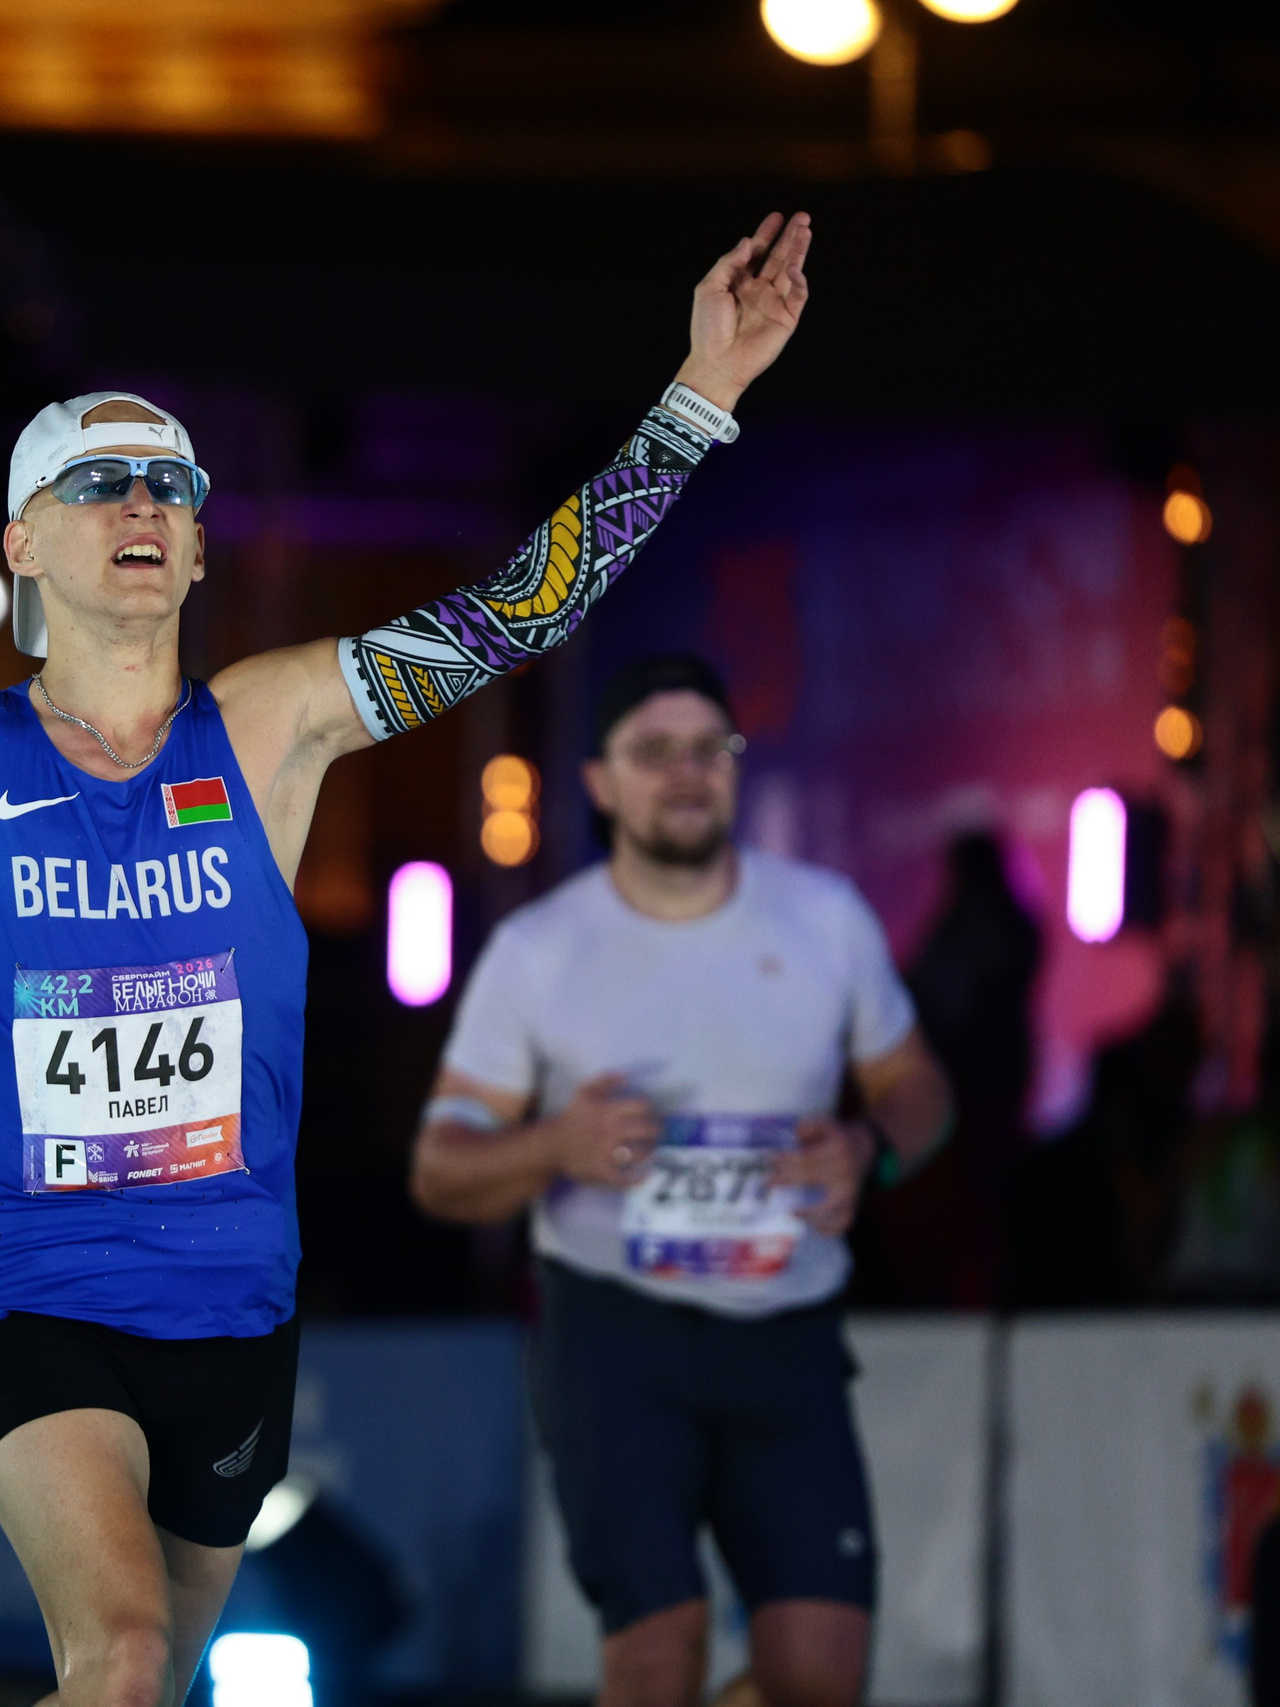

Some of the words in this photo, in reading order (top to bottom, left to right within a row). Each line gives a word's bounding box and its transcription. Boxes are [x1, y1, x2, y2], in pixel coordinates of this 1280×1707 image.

[11, 846, 232, 920] BELARUS
[111, 970, 171, 982] СБЕРПРАЙМ
[176, 958, 213, 974] 2026
[40, 974, 94, 998] 42,2
[112, 979, 166, 1001] БЕЛЫЕ
[168, 970, 216, 996] НОЧИ
[40, 997, 80, 1017] КМ
[114, 987, 203, 1013] МАРАФОН
[45, 1016, 215, 1095] 4146
[109, 1095, 169, 1119] ПАВЕЛ
[56, 1144, 76, 1178] F
[179, 1159, 207, 1171] МАГНИТ
[98, 1175, 119, 1183] BRICS
[127, 1167, 163, 1180] FONBET
